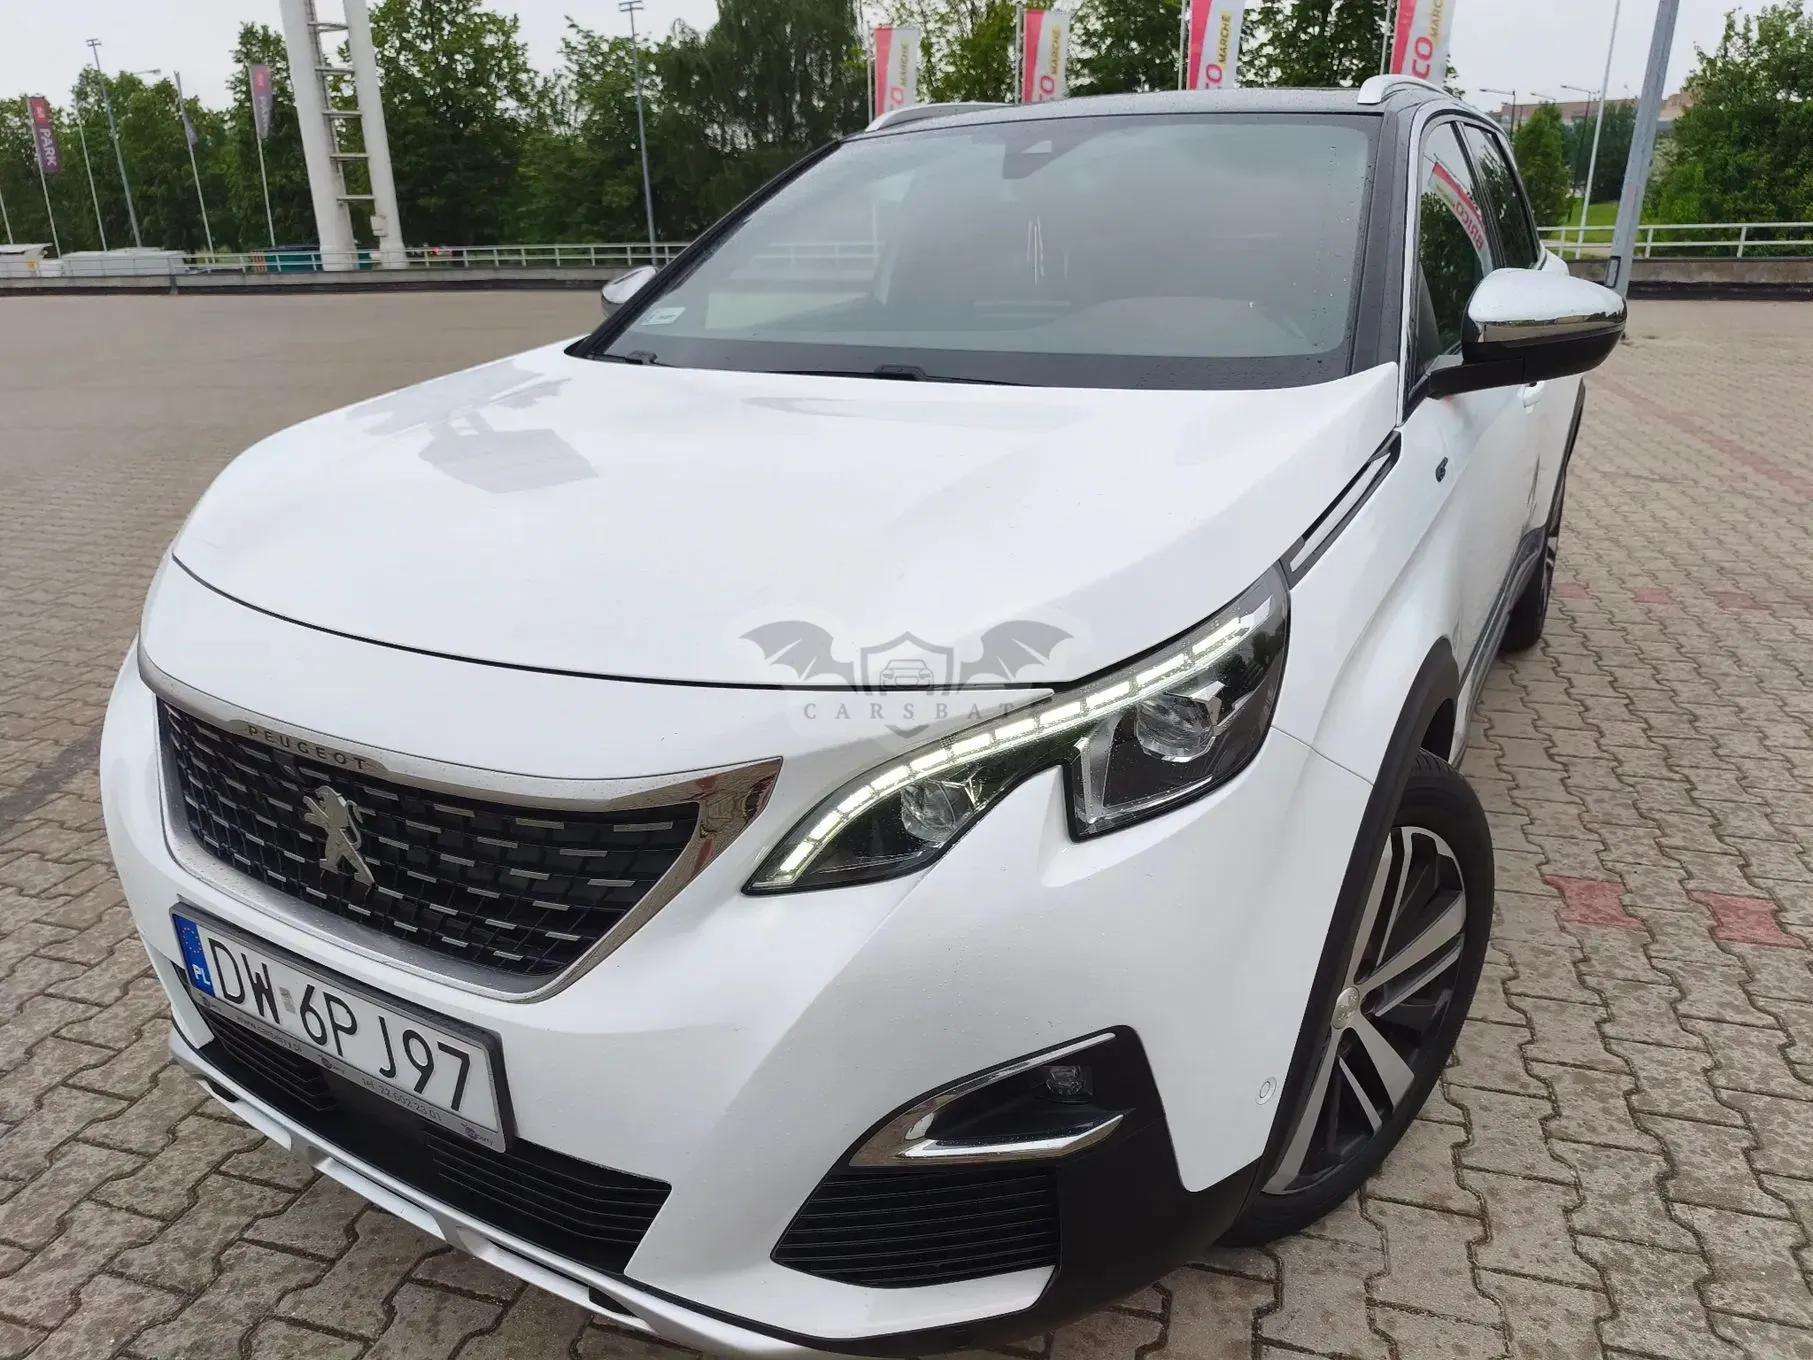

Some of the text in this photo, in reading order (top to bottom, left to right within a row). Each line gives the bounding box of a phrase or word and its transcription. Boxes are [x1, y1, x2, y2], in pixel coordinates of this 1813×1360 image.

[39, 128, 57, 167] PARK
[248, 724, 367, 770] PEUGEOT
[192, 963, 211, 987] PL
[207, 936, 281, 1025] DW
